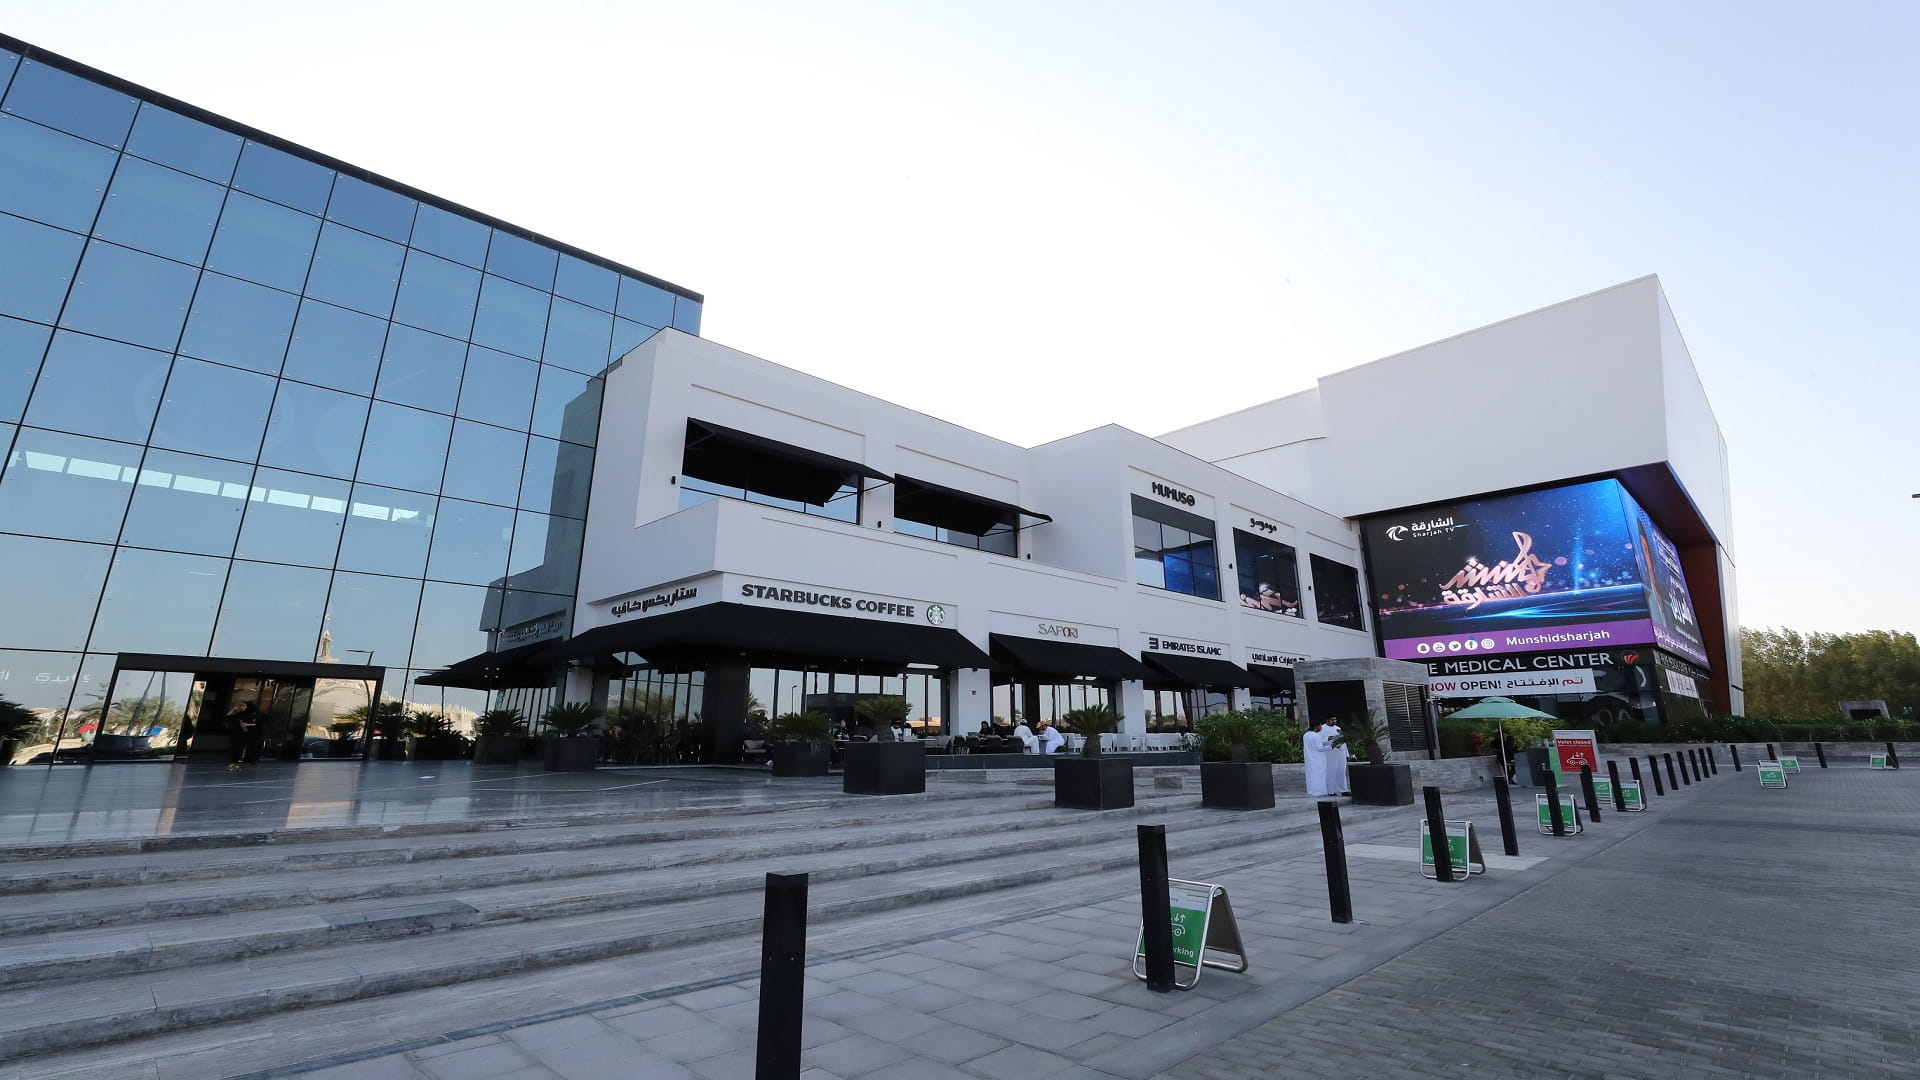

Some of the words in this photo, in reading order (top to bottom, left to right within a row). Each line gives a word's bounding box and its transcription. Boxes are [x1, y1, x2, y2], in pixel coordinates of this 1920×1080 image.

[1152, 481, 1195, 506] MUMUSO
[1411, 517, 1453, 532] الشارقة
[1412, 529, 1442, 537] Sharjah
[641, 587, 697, 612] ستاربكس
[741, 583, 852, 609] STARBUCKS
[855, 599, 915, 618] COFFEE
[611, 600, 641, 617] كافيه
[1038, 623, 1078, 639] SAPORI
[1506, 630, 1610, 646] Munshidsharjah
[1162, 640, 1195, 653] EMIRATES
[1197, 645, 1222, 656] ISLAMIC
[1445, 658, 1526, 674] MEDICAL
[1532, 652, 1614, 668] CENTER
[1460, 680, 1501, 691] OPEN!
